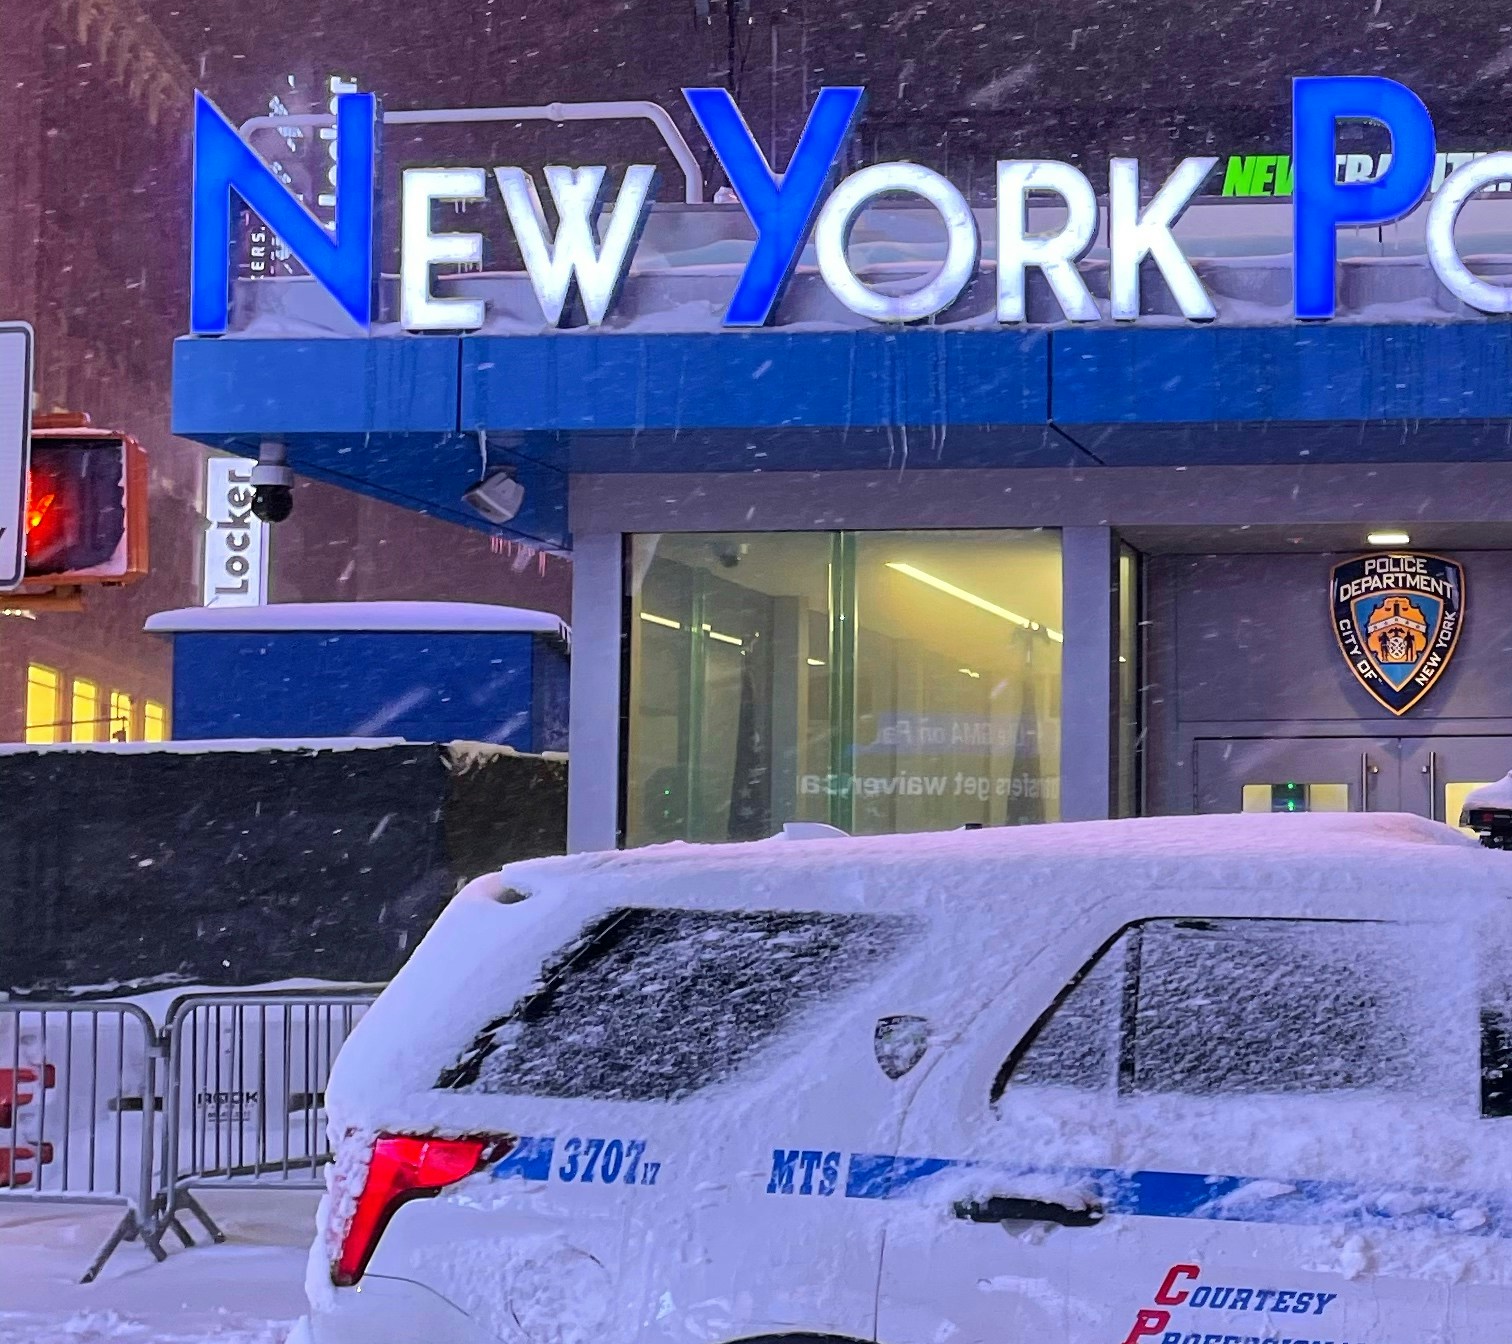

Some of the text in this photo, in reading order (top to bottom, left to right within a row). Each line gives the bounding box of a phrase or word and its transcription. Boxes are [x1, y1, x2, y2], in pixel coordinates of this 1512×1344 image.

[190, 86, 657, 335] NEW
[681, 85, 1220, 327] YORK
[214, 468, 252, 596] Locker
[1339, 573, 1453, 603] DEPARTMENT
[1364, 557, 1428, 575] POLICE
[1338, 618, 1378, 681] CITY OF
[1414, 609, 1457, 687] NEW YORK
[558, 1136, 648, 1185] 3707
[766, 1149, 841, 1197] MTS
[1154, 1263, 1338, 1316] COURTESY
